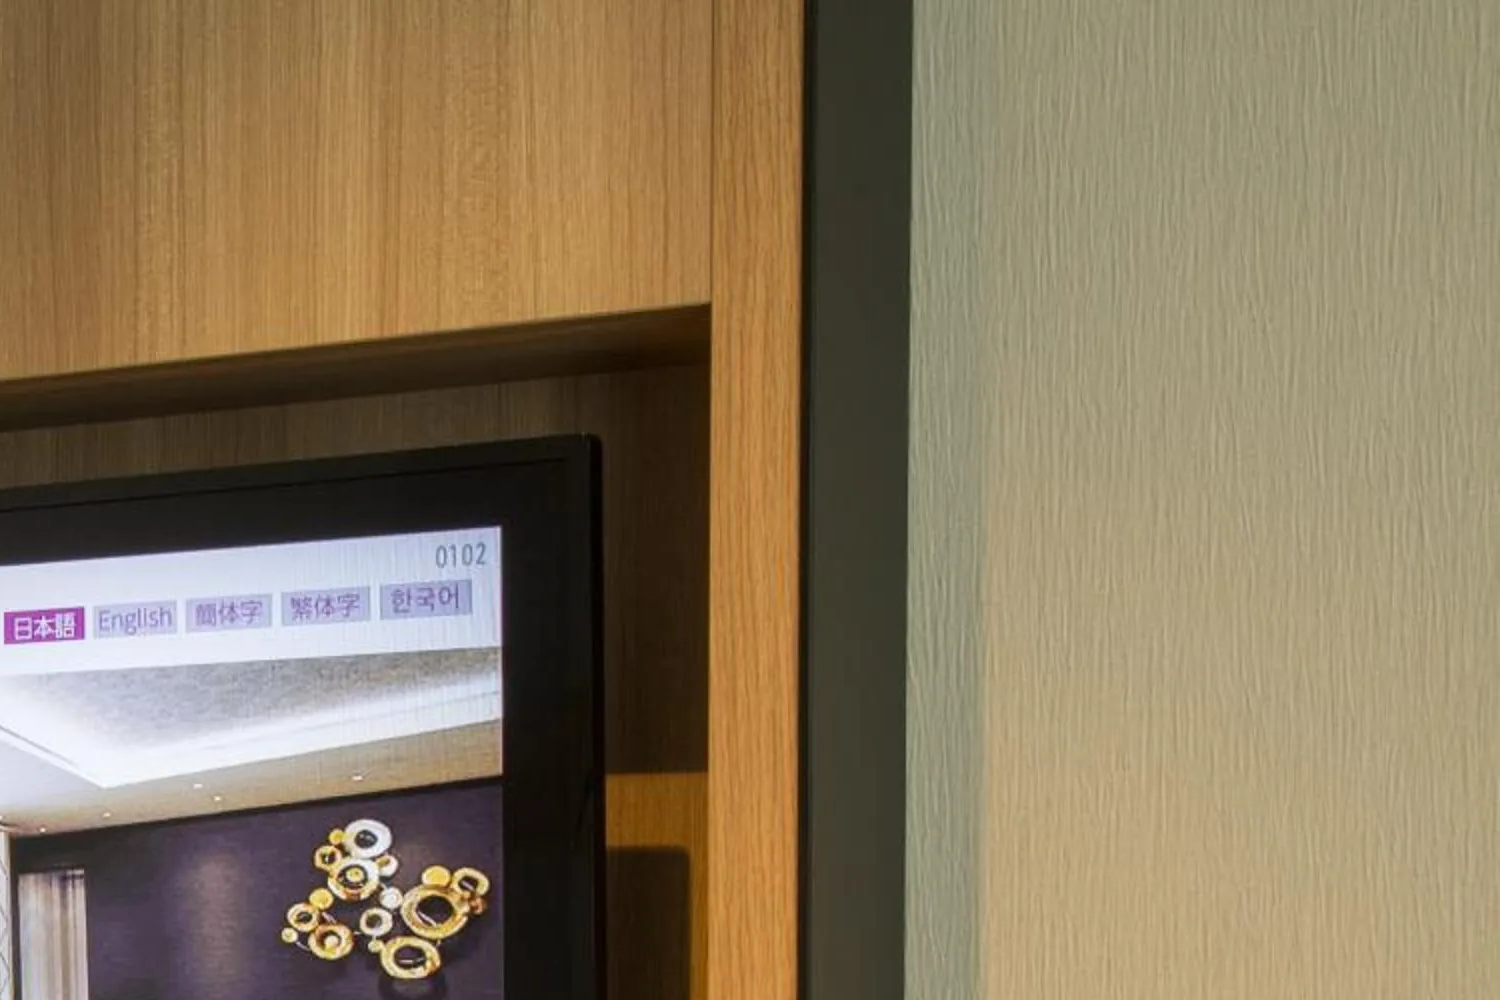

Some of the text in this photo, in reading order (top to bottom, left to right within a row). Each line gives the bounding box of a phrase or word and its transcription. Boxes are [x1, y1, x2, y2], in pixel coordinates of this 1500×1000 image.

[435, 541, 486, 568] 0102
[390, 583, 459, 614] 한국어
[13, 612, 76, 640] 日本語
[99, 606, 172, 636] English
